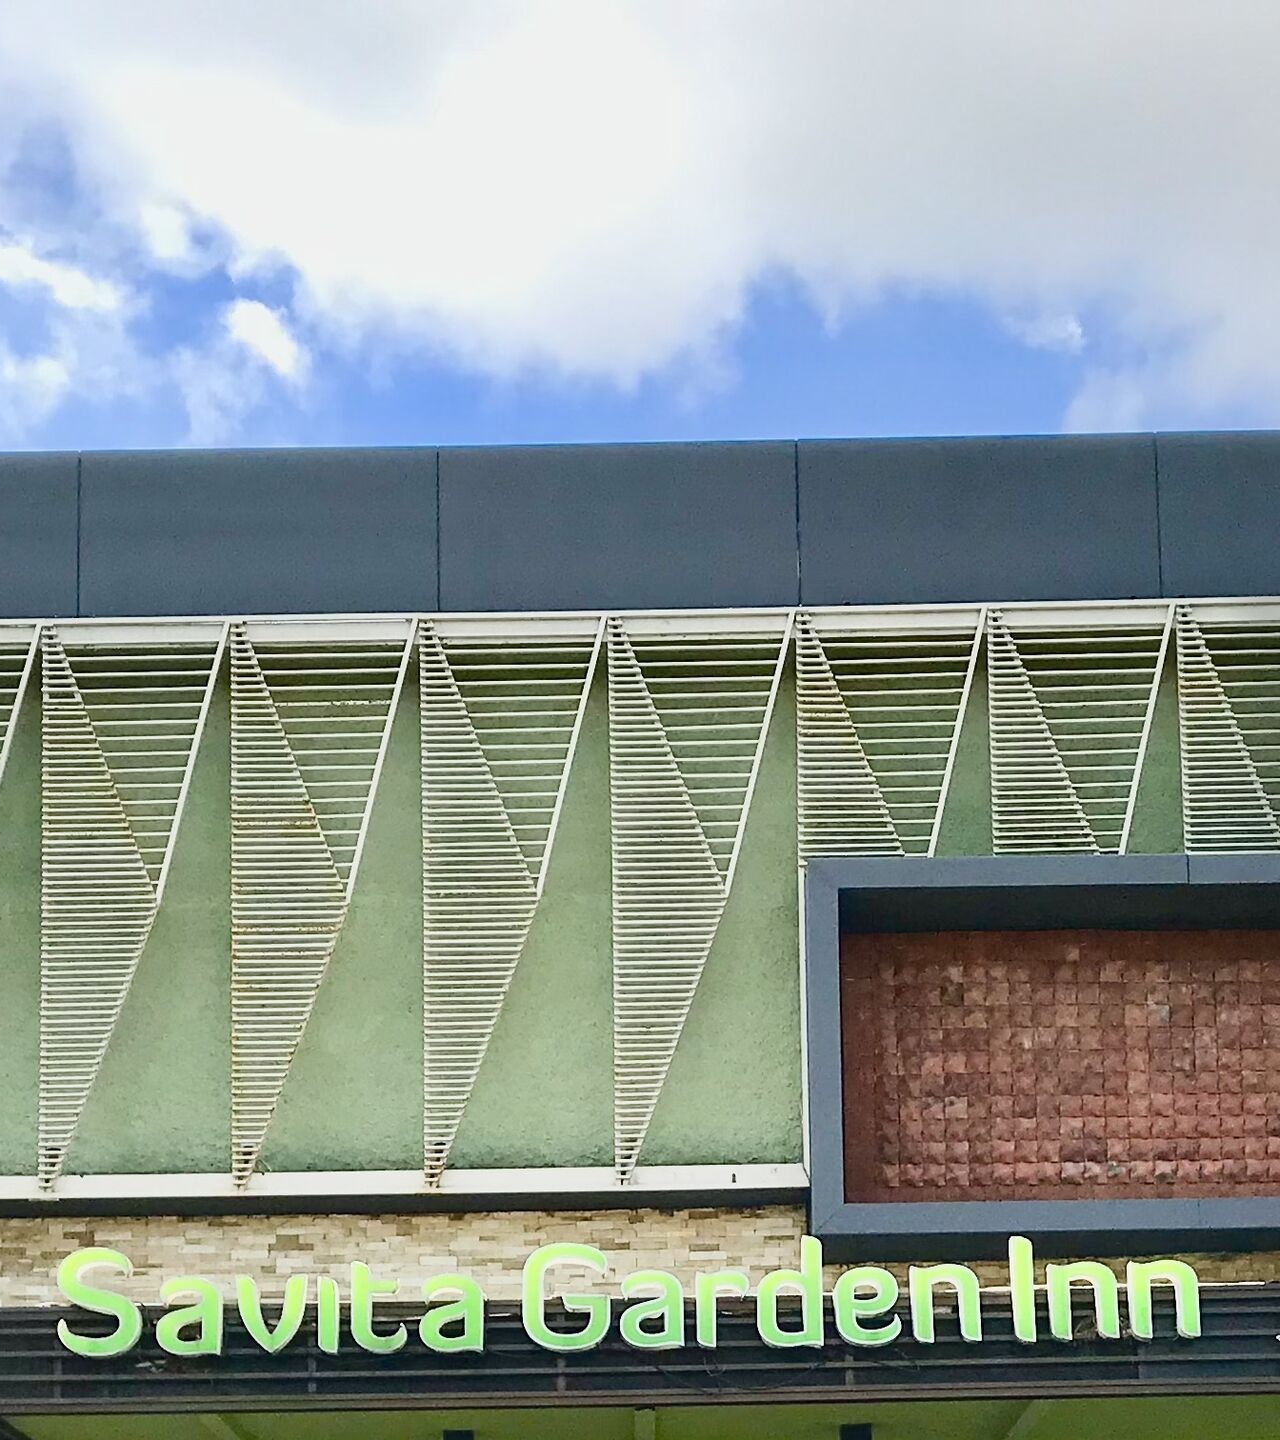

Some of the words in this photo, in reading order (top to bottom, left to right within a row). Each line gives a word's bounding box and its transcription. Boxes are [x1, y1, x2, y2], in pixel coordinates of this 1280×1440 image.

[56, 1246, 488, 1357] Savita
[521, 1235, 983, 1353] Garden
[1008, 1235, 1202, 1344] Inn
